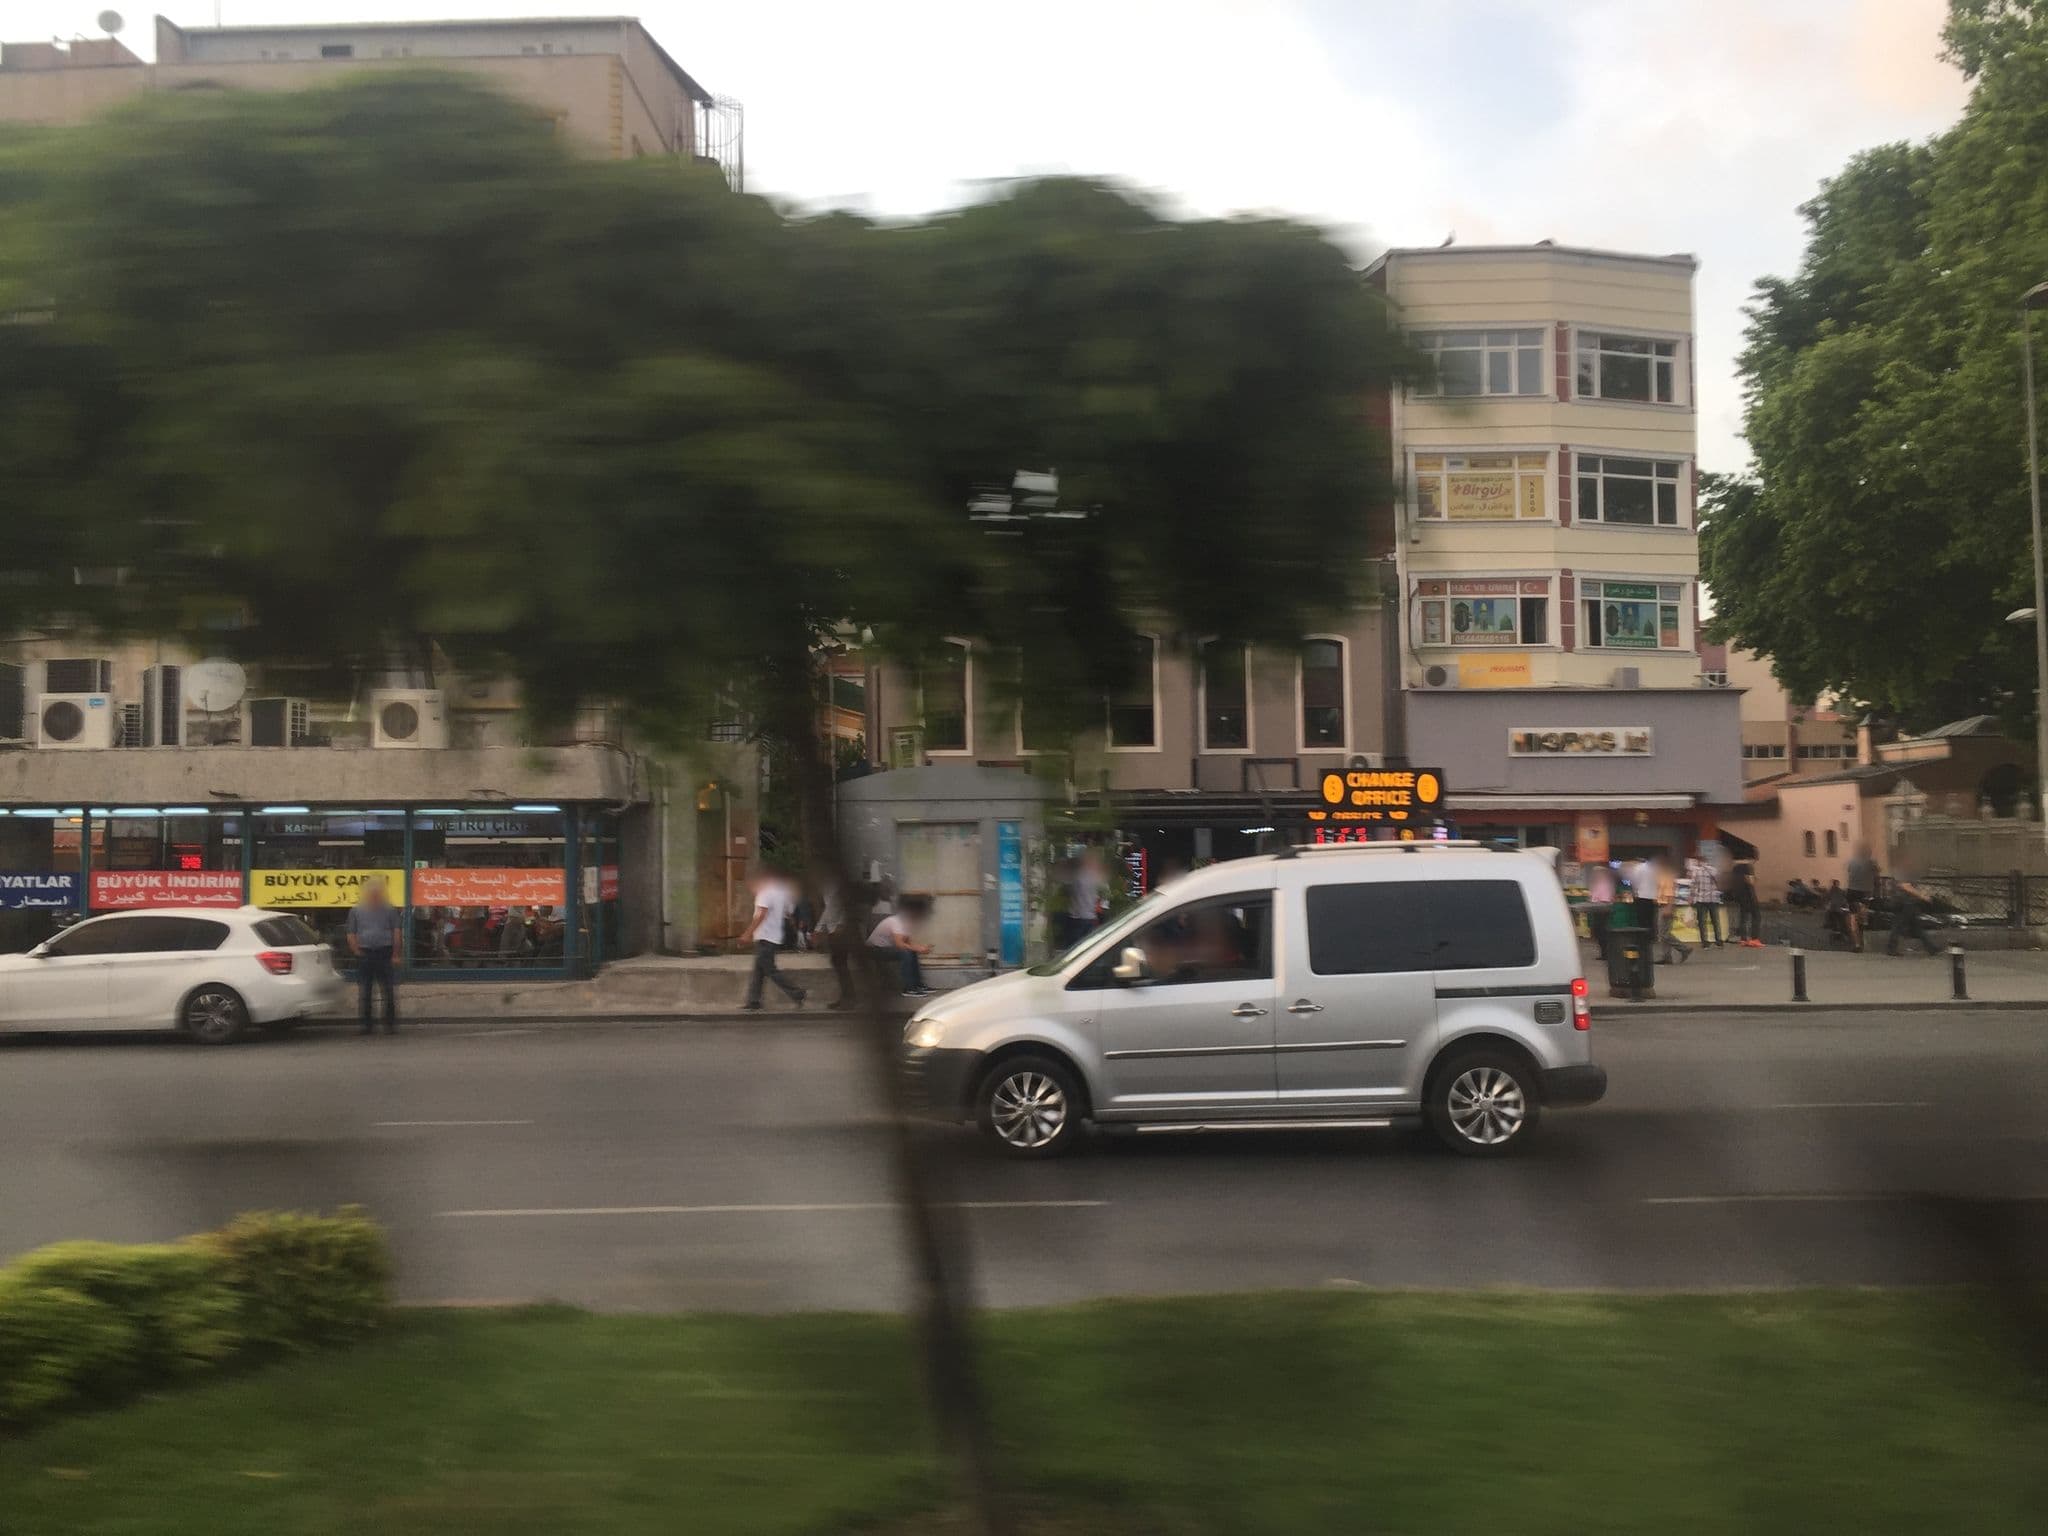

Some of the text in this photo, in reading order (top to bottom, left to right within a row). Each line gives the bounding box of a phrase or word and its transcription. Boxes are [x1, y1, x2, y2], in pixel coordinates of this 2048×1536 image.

[1346, 772, 1415, 787] CHANGE
[1351, 790, 1411, 805] OFFICE
[433, 821, 487, 831] METRO
[0, 876, 72, 888] YATLAR
[97, 873, 241, 888] BÜYÜK İNDİRİM
[264, 873, 329, 887] BÜYÜK
